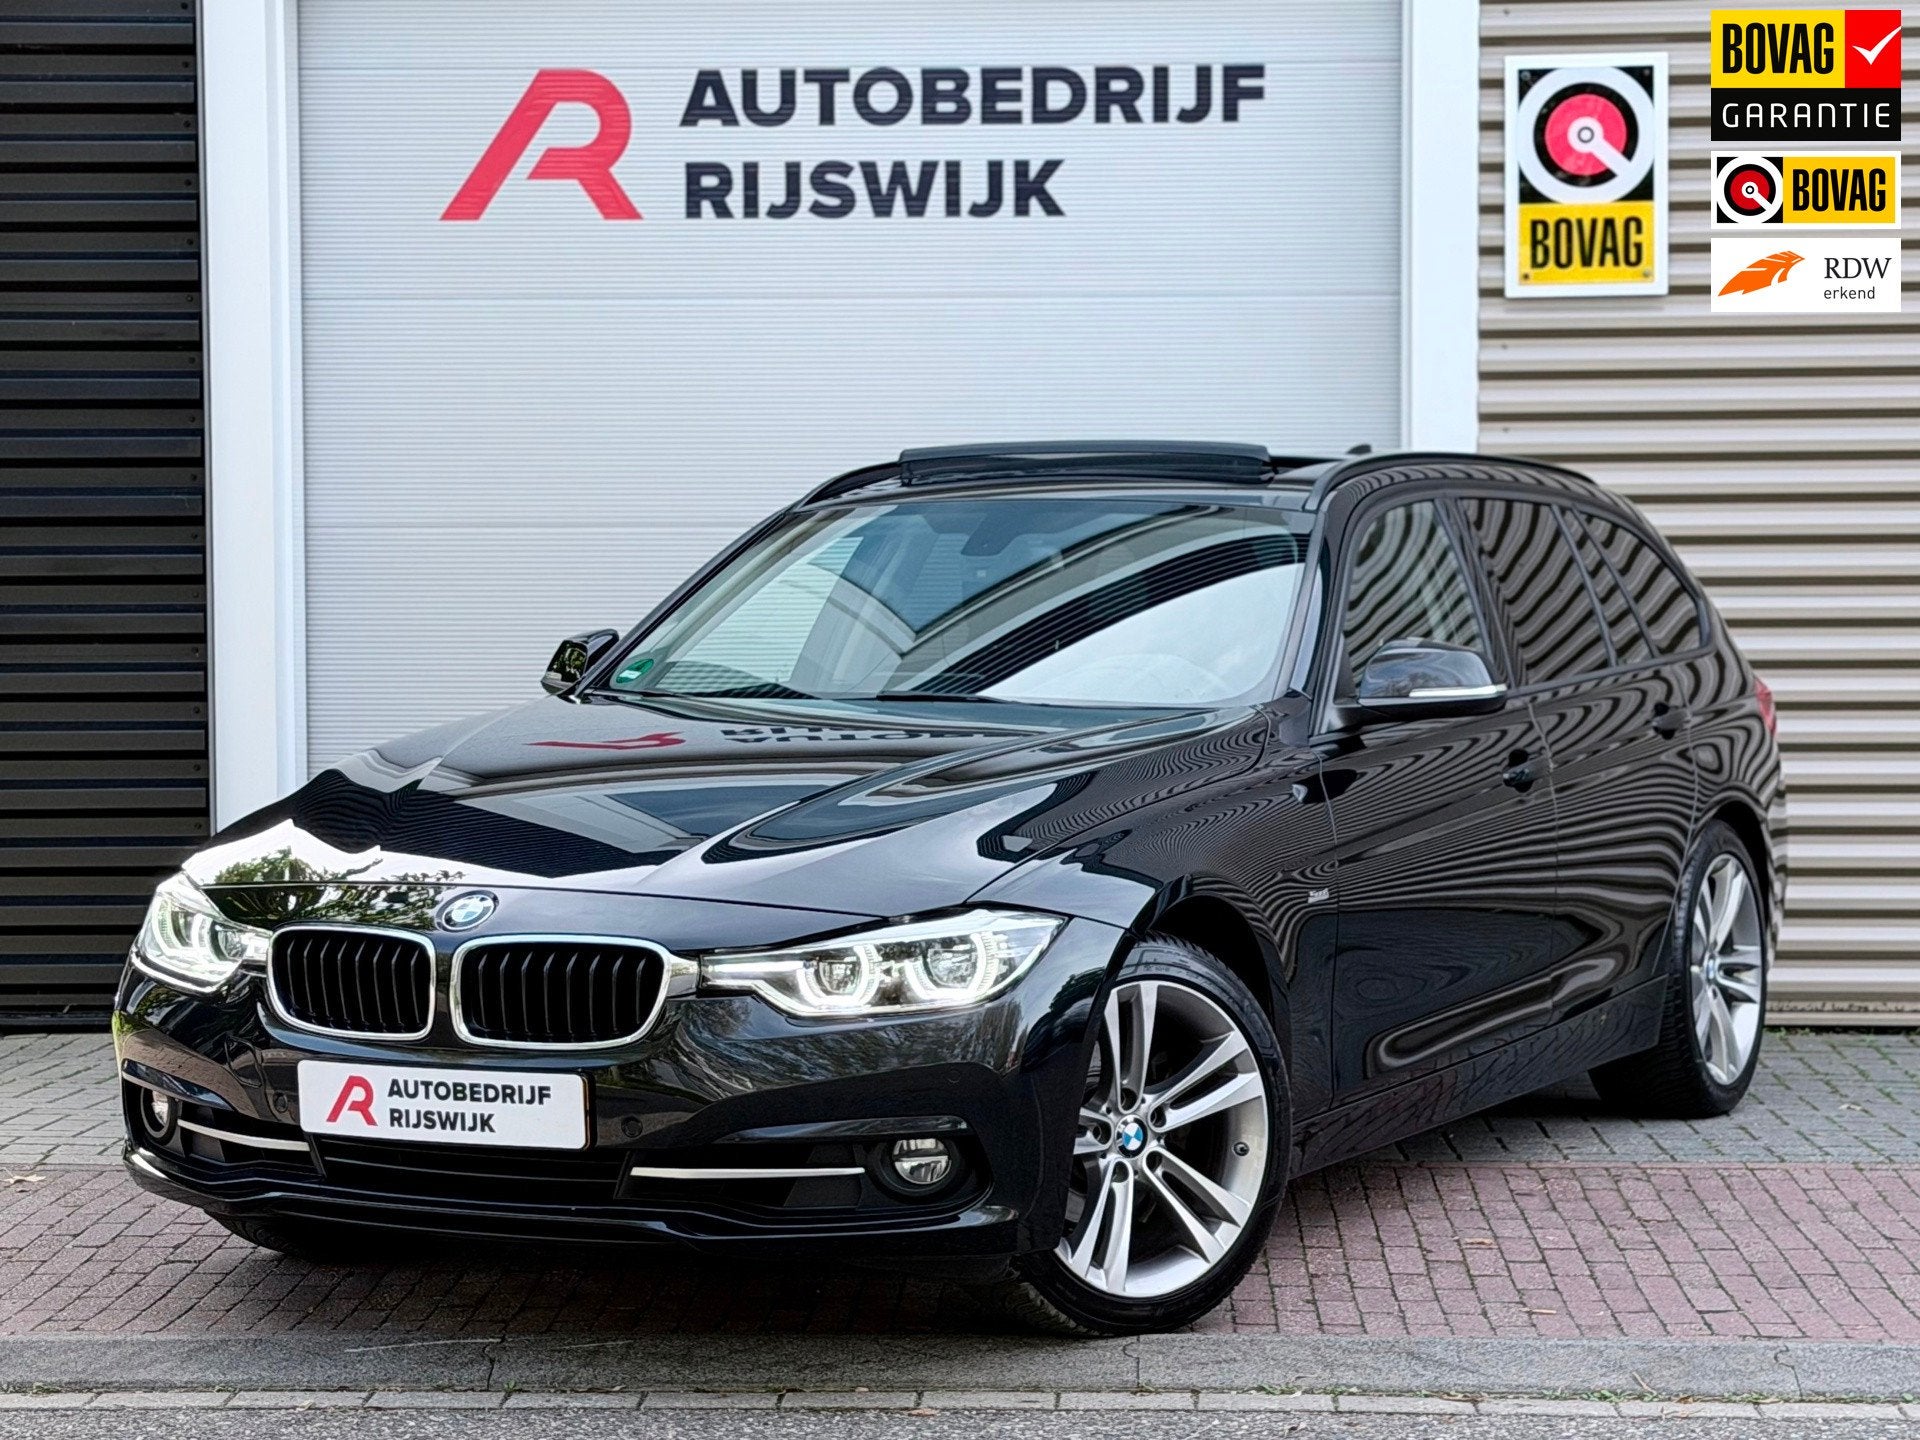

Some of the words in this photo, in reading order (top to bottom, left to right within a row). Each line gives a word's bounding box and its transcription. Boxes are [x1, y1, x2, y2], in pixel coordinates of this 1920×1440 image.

[680, 65, 1265, 127] AUTOBEDRIJF
[686, 159, 1066, 219] RIJSWIJK
[1530, 217, 1644, 270] BOVAG
[387, 1078, 552, 1106] AUTOBEDRIJF
[389, 1108, 496, 1134] RIJSWIJK
